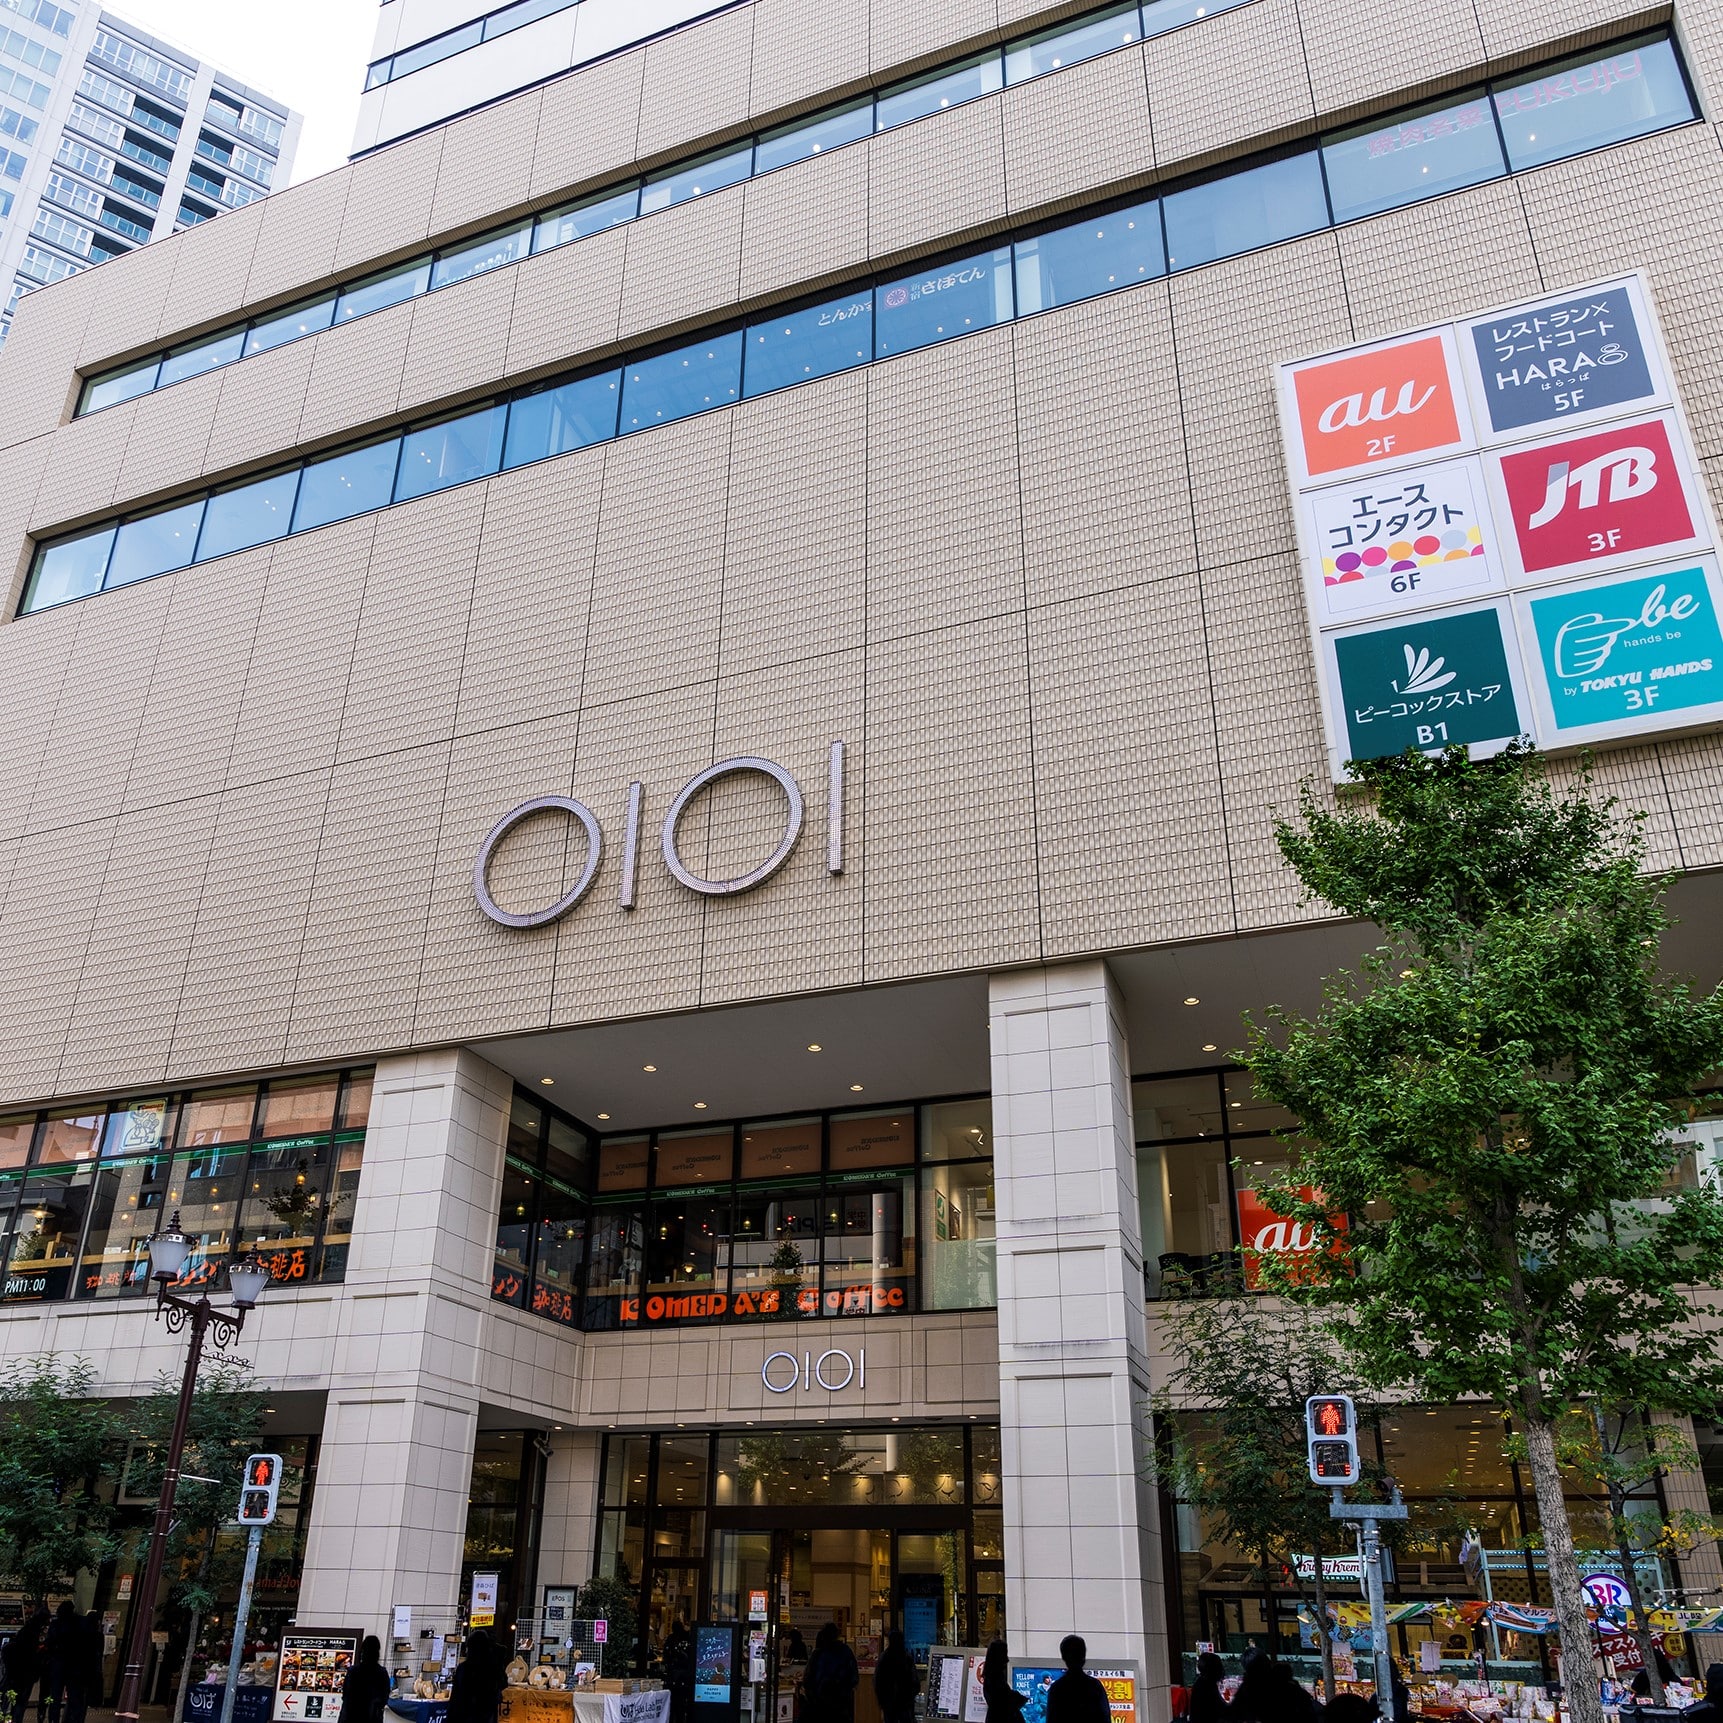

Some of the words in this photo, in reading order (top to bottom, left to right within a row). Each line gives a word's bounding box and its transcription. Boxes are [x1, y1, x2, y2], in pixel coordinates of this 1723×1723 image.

[1495, 54, 1642, 117] FUKUJU
[1495, 320, 1615, 362] フードコート
[1541, 373, 1590, 392] はらっぱ
[1317, 379, 1437, 434] au
[1554, 387, 1586, 412] 5F
[1366, 434, 1396, 457] 2F
[1528, 445, 1658, 531] JTB
[1351, 483, 1428, 520] エース
[1328, 503, 1465, 549] コンタクト
[1587, 528, 1623, 552] 3F
[1389, 571, 1422, 594] 6F
[1640, 583, 1700, 629] be
[1623, 633, 1663, 650] hands
[1665, 629, 1682, 643] be
[1563, 686, 1578, 698] by
[1580, 670, 1643, 693] TOKYU
[1649, 658, 1713, 682] HANDS
[1354, 683, 1502, 724] ピーコックストア
[1624, 688, 1661, 711] 3F
[1416, 721, 1450, 745] B1
[4, 1277, 46, 1295] PM11:00
[1299, 1559, 1332, 1574] Kripy
[1612, 1648, 1642, 1668] 受付
